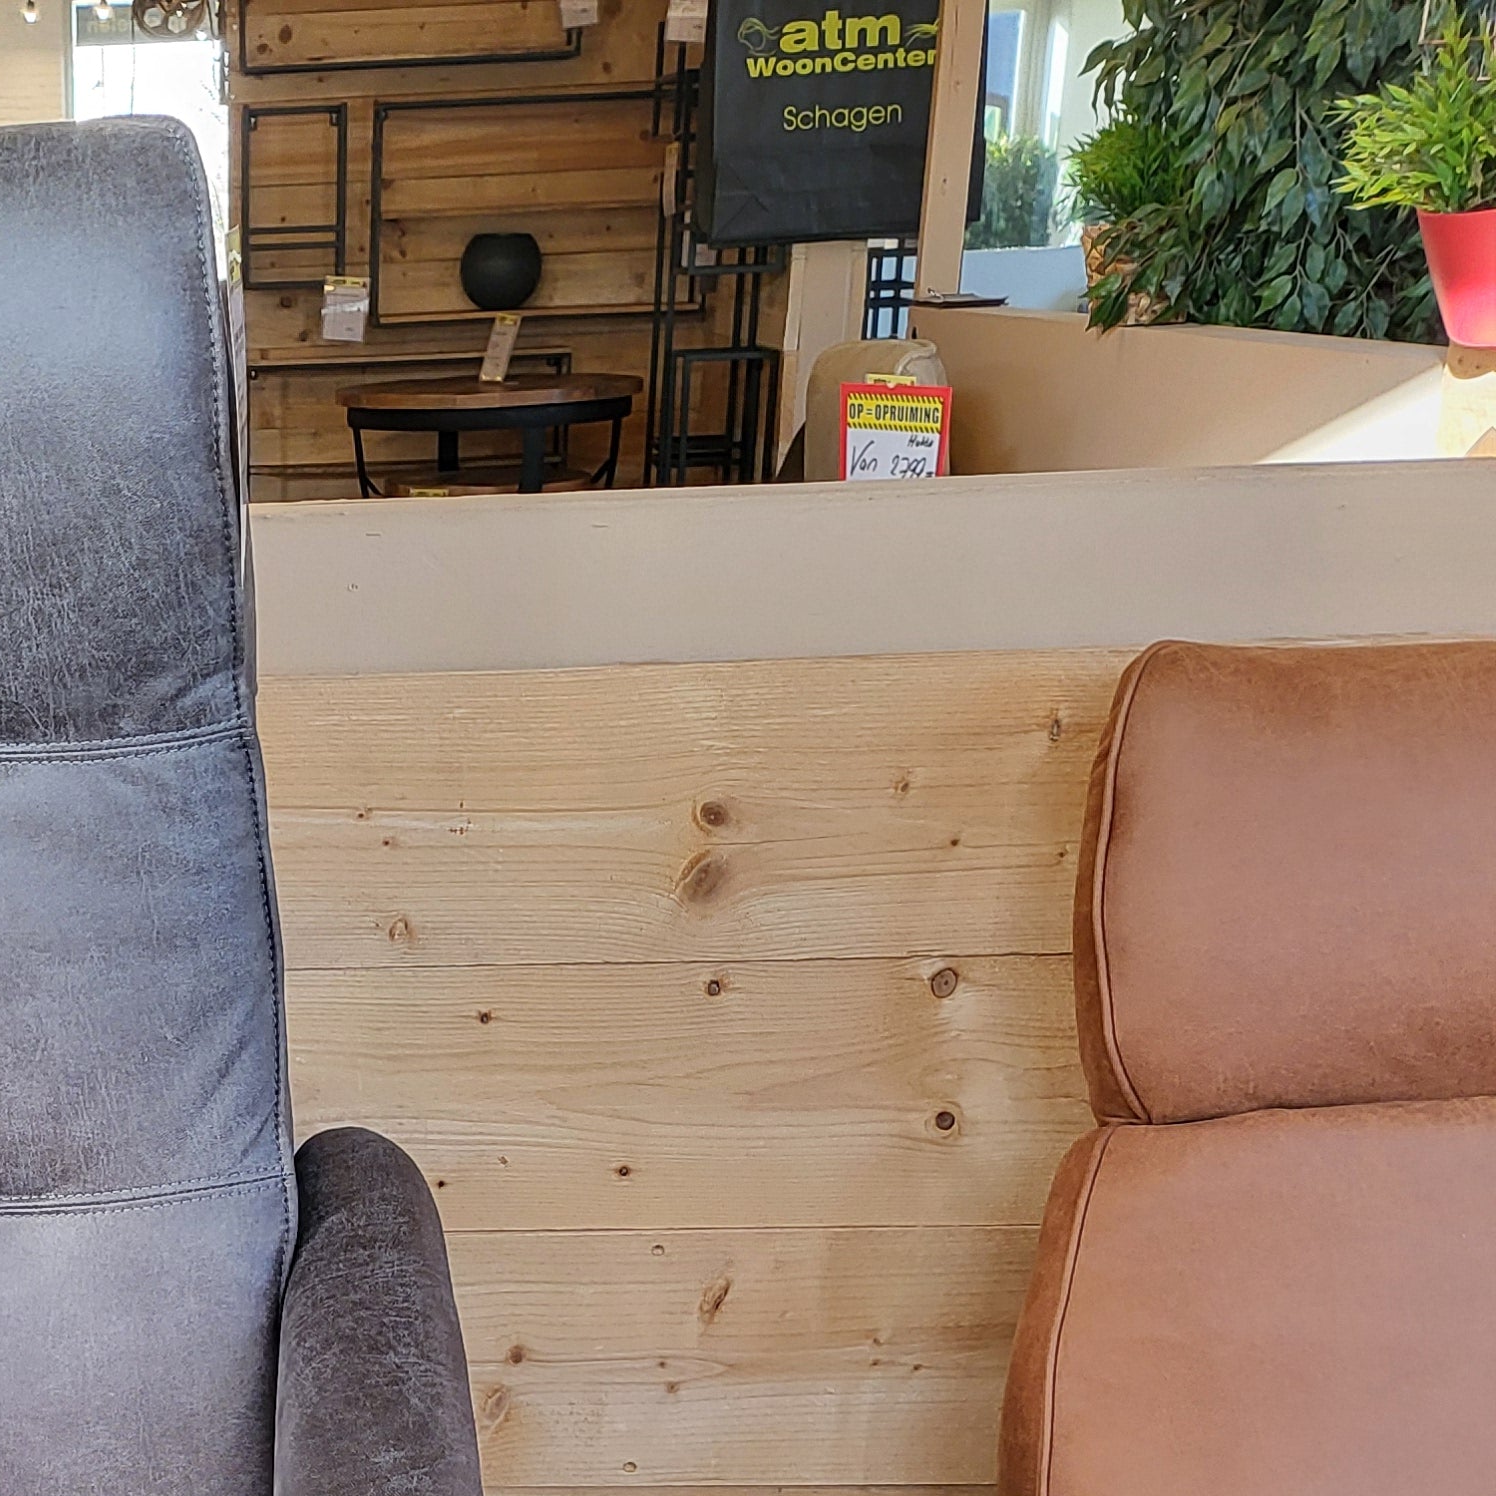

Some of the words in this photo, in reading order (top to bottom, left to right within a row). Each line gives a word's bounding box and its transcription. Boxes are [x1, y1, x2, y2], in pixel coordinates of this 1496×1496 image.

[779, 10, 901, 54] atm
[746, 47, 937, 78] WoonCenter
[783, 104, 903, 132] Schagen
[849, 403, 864, 420] OP
[874, 404, 940, 424] OPRUIMING
[850, 440, 878, 477] Van
